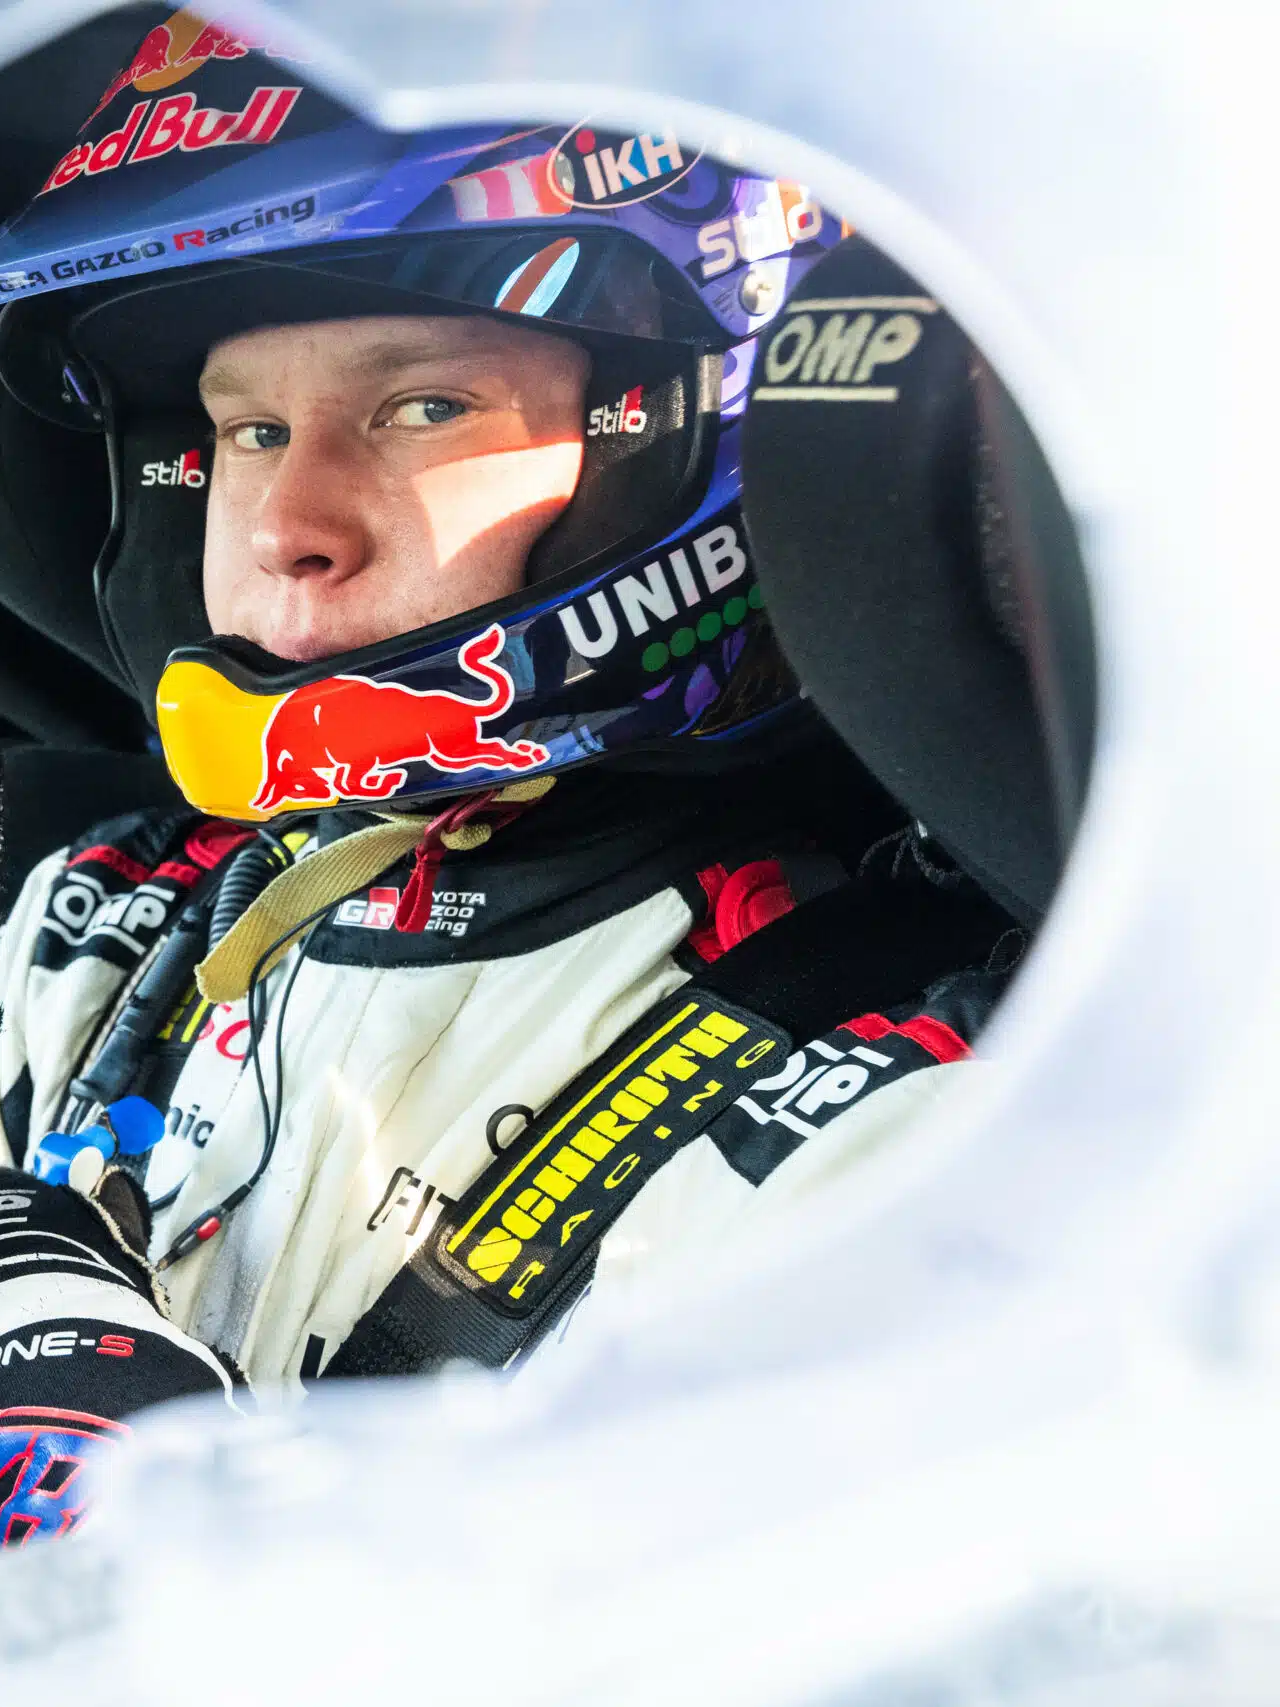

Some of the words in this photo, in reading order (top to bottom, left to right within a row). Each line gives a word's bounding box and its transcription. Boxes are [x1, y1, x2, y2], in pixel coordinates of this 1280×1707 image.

[126, 87, 304, 165] Bull
[50, 239, 166, 281] GAZOO
[173, 195, 316, 251] Racing
[765, 311, 923, 383] OMP
[586, 390, 648, 438] stilo
[140, 451, 206, 489] stilo
[557, 524, 747, 659] UNIB
[337, 899, 396, 927] GR
[430, 904, 475, 919] ZOO
[431, 890, 487, 906] YOTA
[424, 918, 469, 938] cing
[467, 1011, 750, 1284] SCHROTH
